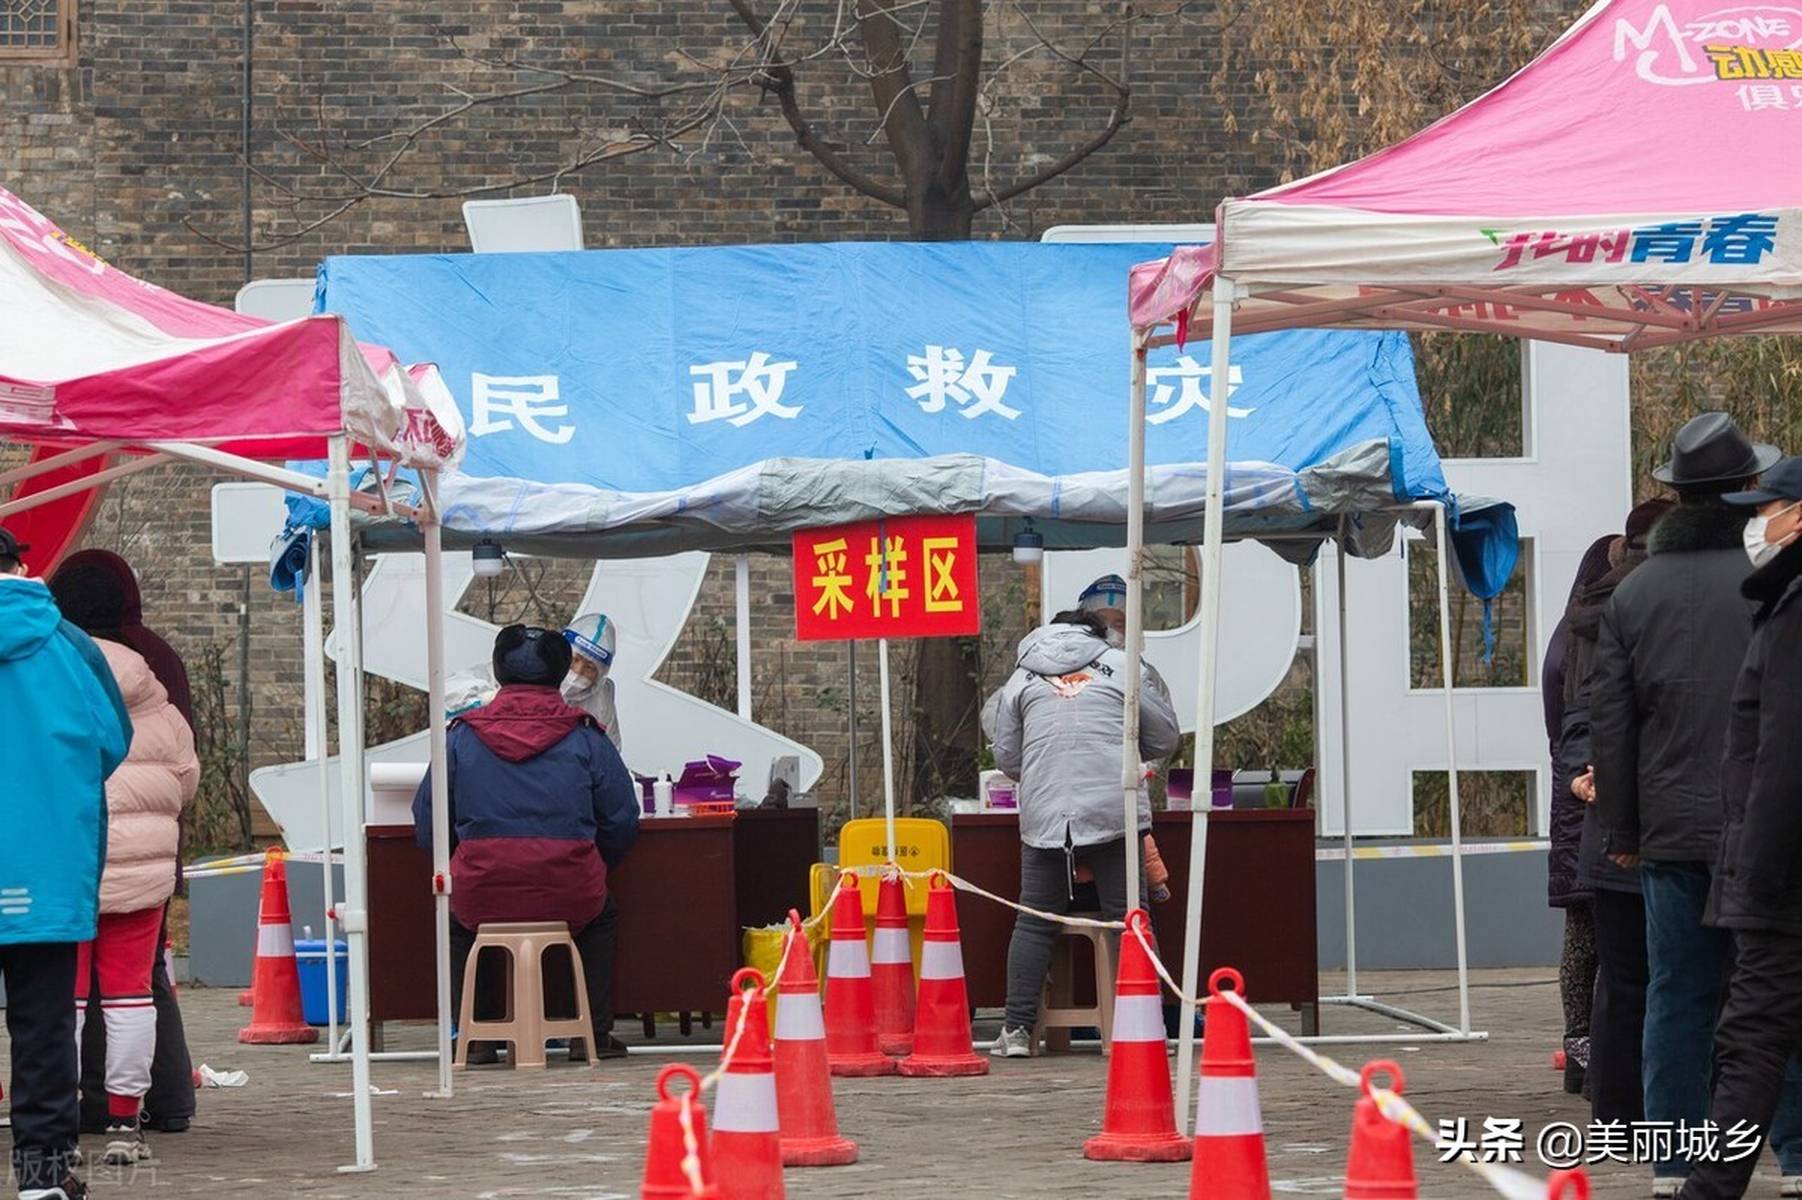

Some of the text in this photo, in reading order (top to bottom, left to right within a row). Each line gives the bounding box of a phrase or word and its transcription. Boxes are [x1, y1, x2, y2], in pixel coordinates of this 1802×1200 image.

[1735, 84, 1802, 111] 俱
[812, 535, 963, 620] 采样区
